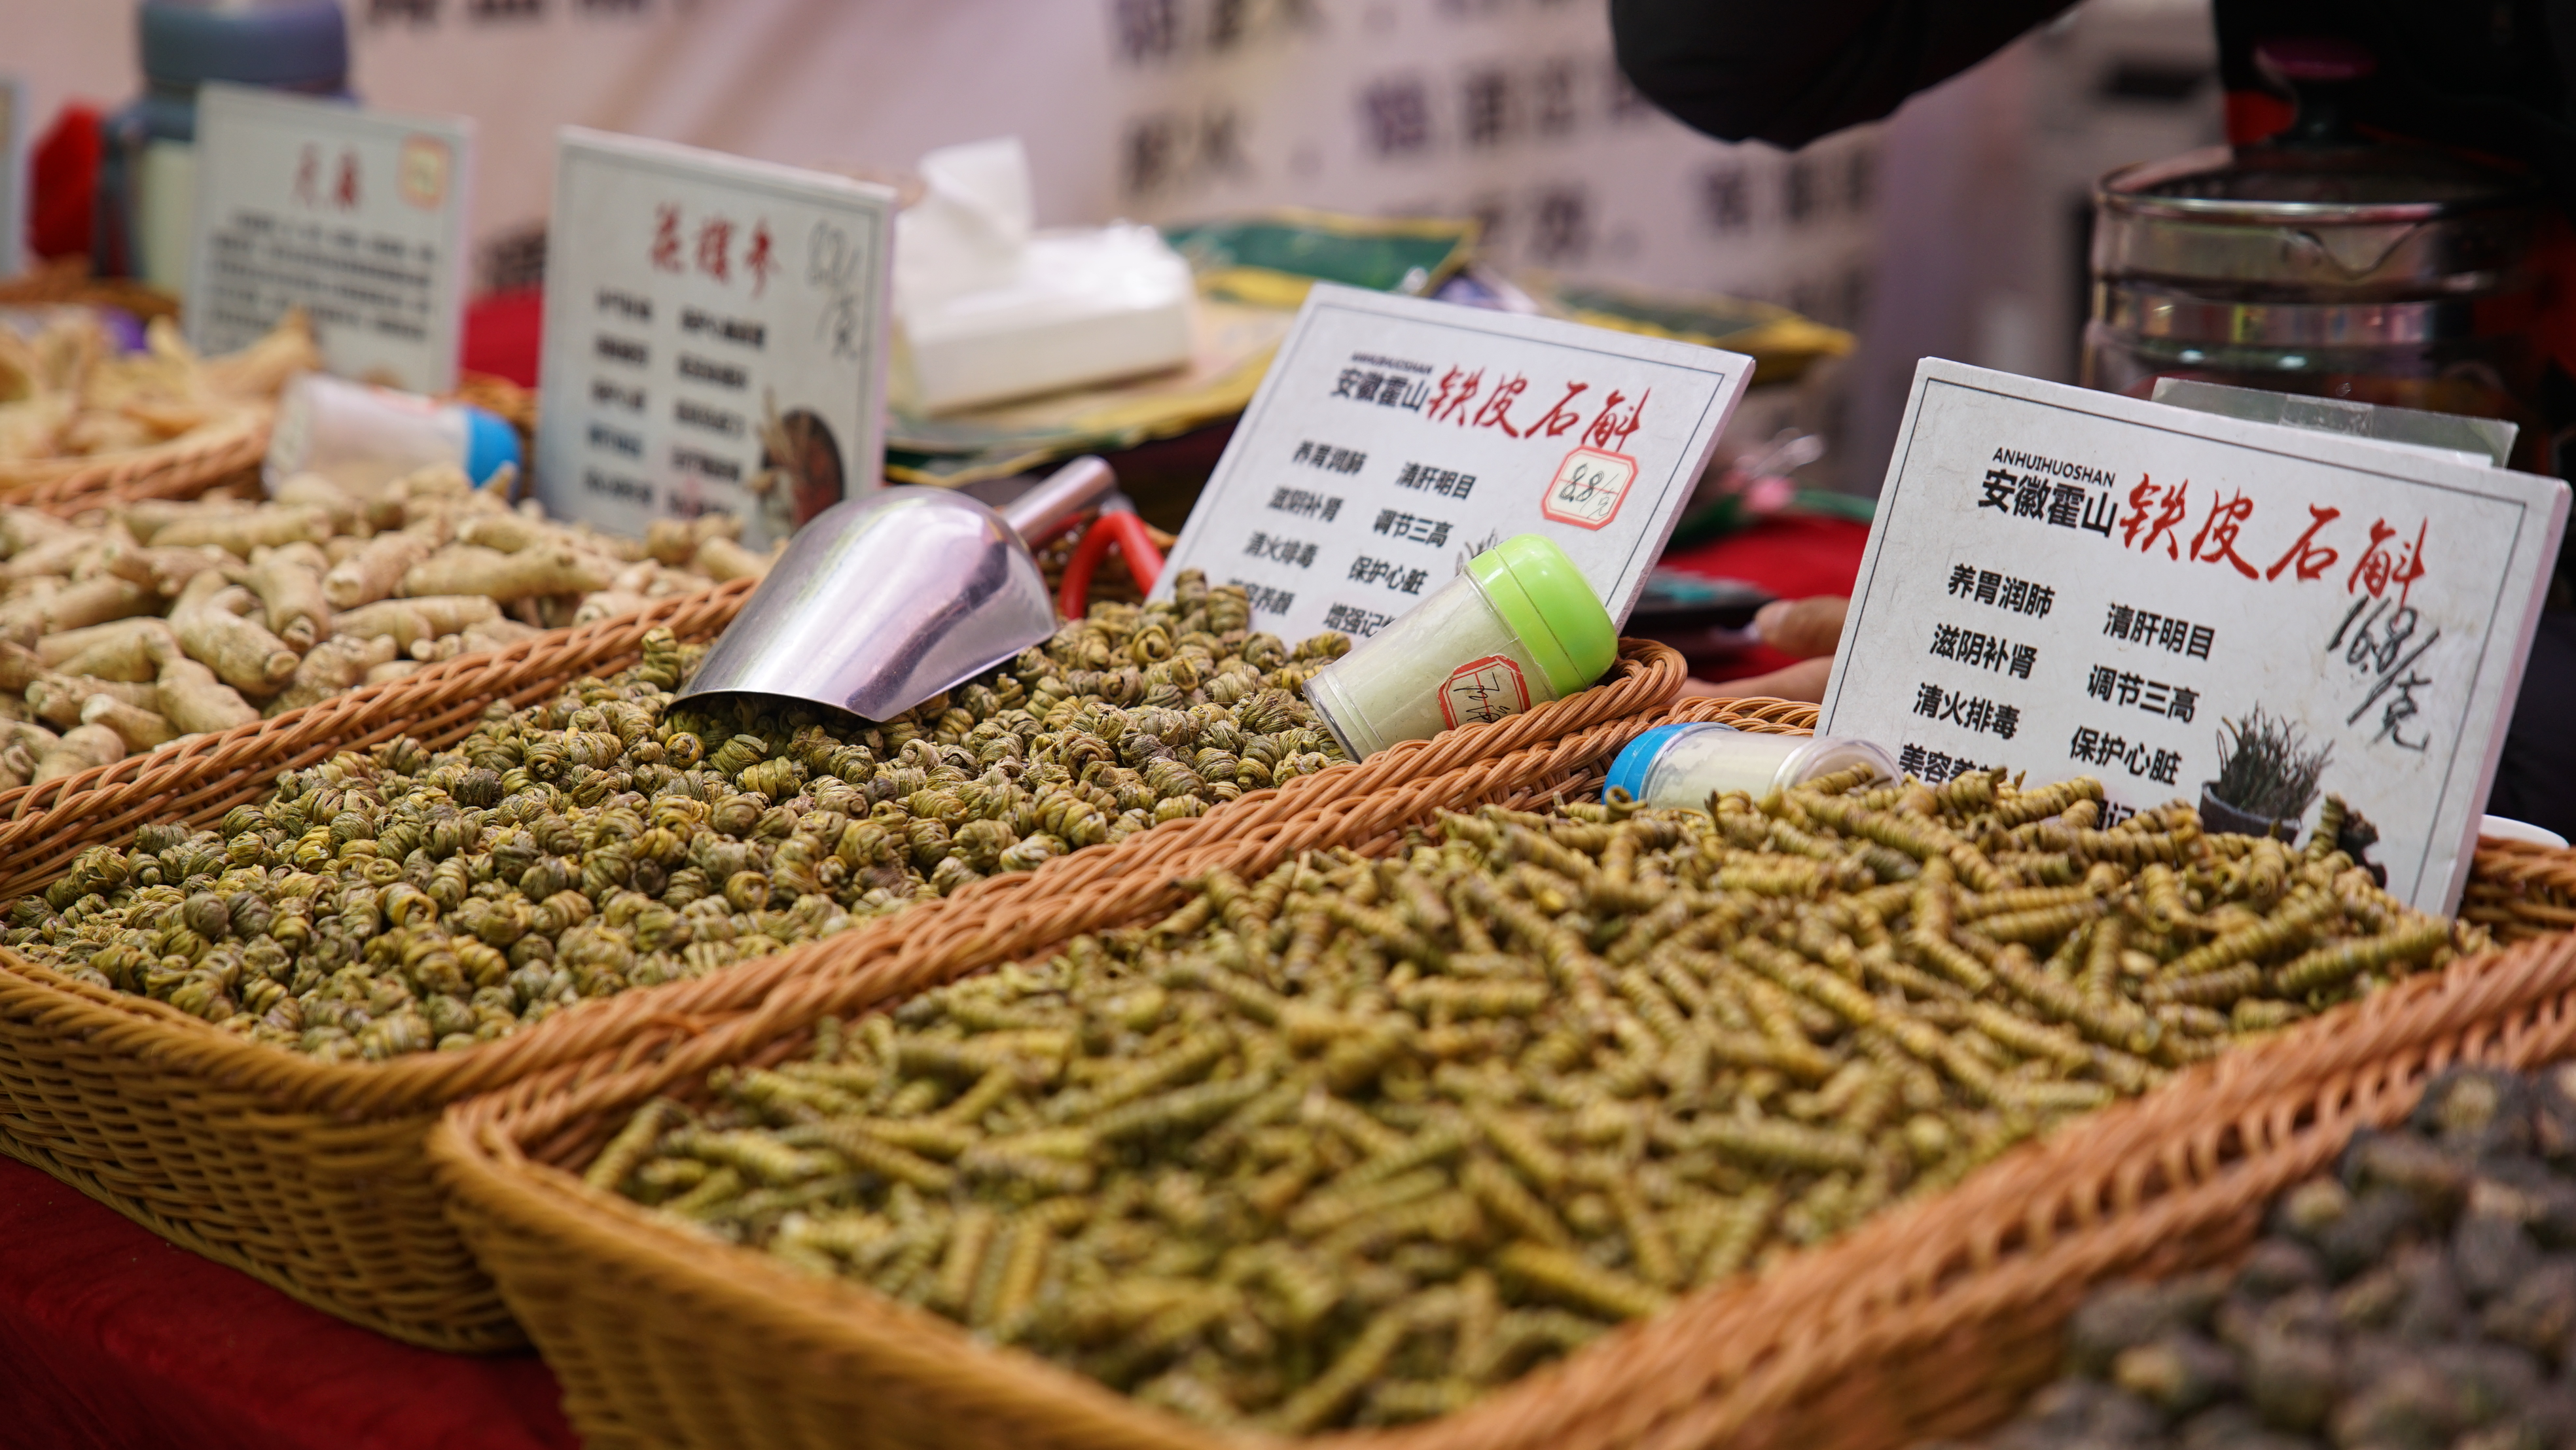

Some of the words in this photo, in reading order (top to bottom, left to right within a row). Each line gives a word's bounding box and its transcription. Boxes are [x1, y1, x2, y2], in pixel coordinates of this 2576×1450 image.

[1331, 367, 1430, 413] 安徽霍山
[1395, 461, 1476, 500] 清肝明目
[1992, 446, 2117, 489] ANHUIHUOSHAN
[1372, 508, 1454, 548] 调节三高
[1978, 469, 2119, 539] 安徽霍山
[2119, 472, 2429, 625] 铁皮石斛
[1228, 578, 1296, 616] 容养颜
[1347, 555, 1428, 595] 保护心脏
[1948, 563, 2056, 620] 养胃润肺
[1322, 601, 1397, 638] 增强记
[2102, 601, 2215, 662] 清肝明目
[1929, 622, 2038, 680] 滋阴补肾
[1912, 681, 2020, 740] 清火排毒
[2086, 663, 2200, 724] 调节三高
[2069, 724, 2182, 786] 保护心脏
